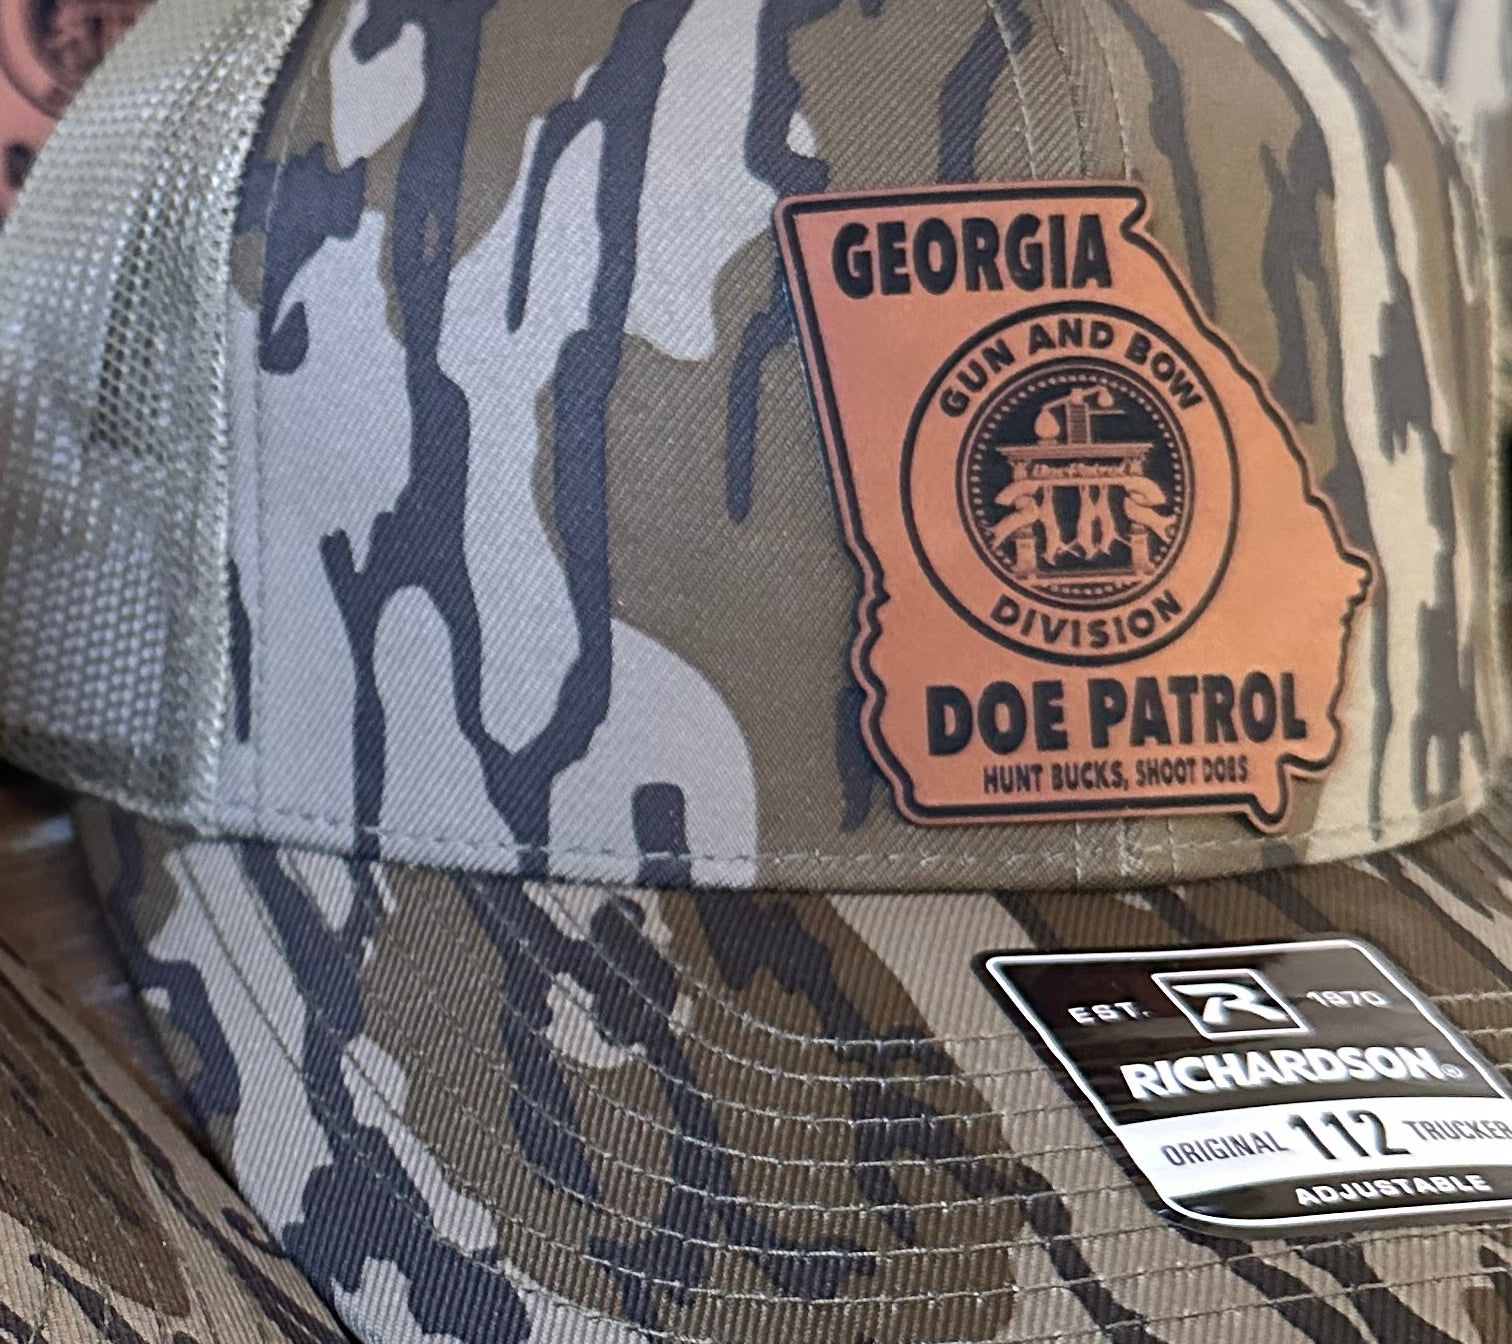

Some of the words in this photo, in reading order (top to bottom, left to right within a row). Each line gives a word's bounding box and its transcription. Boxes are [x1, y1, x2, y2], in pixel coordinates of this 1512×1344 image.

[832, 213, 1113, 298] GEORGIA
[940, 337, 1016, 419] GUN
[1028, 317, 1116, 355] AND
[1125, 330, 1204, 411] BOW
[989, 590, 1184, 648] DIVISION
[926, 678, 1069, 756] DOE
[1088, 670, 1308, 748] PATROL
[983, 761, 1045, 794] HUNT
[1051, 759, 1130, 792] BUCKS,
[1136, 756, 1196, 787] SHOOT
[1203, 755, 1250, 785] DOES
[1068, 1001, 1152, 1025] EST.
[1161, 1130, 1289, 1167] ORIGINAL
[1287, 1109, 1410, 1162] 112
[1402, 1119, 1512, 1142] TRUCKER
[1295, 1174, 1492, 1207] ADJUSTABLE
